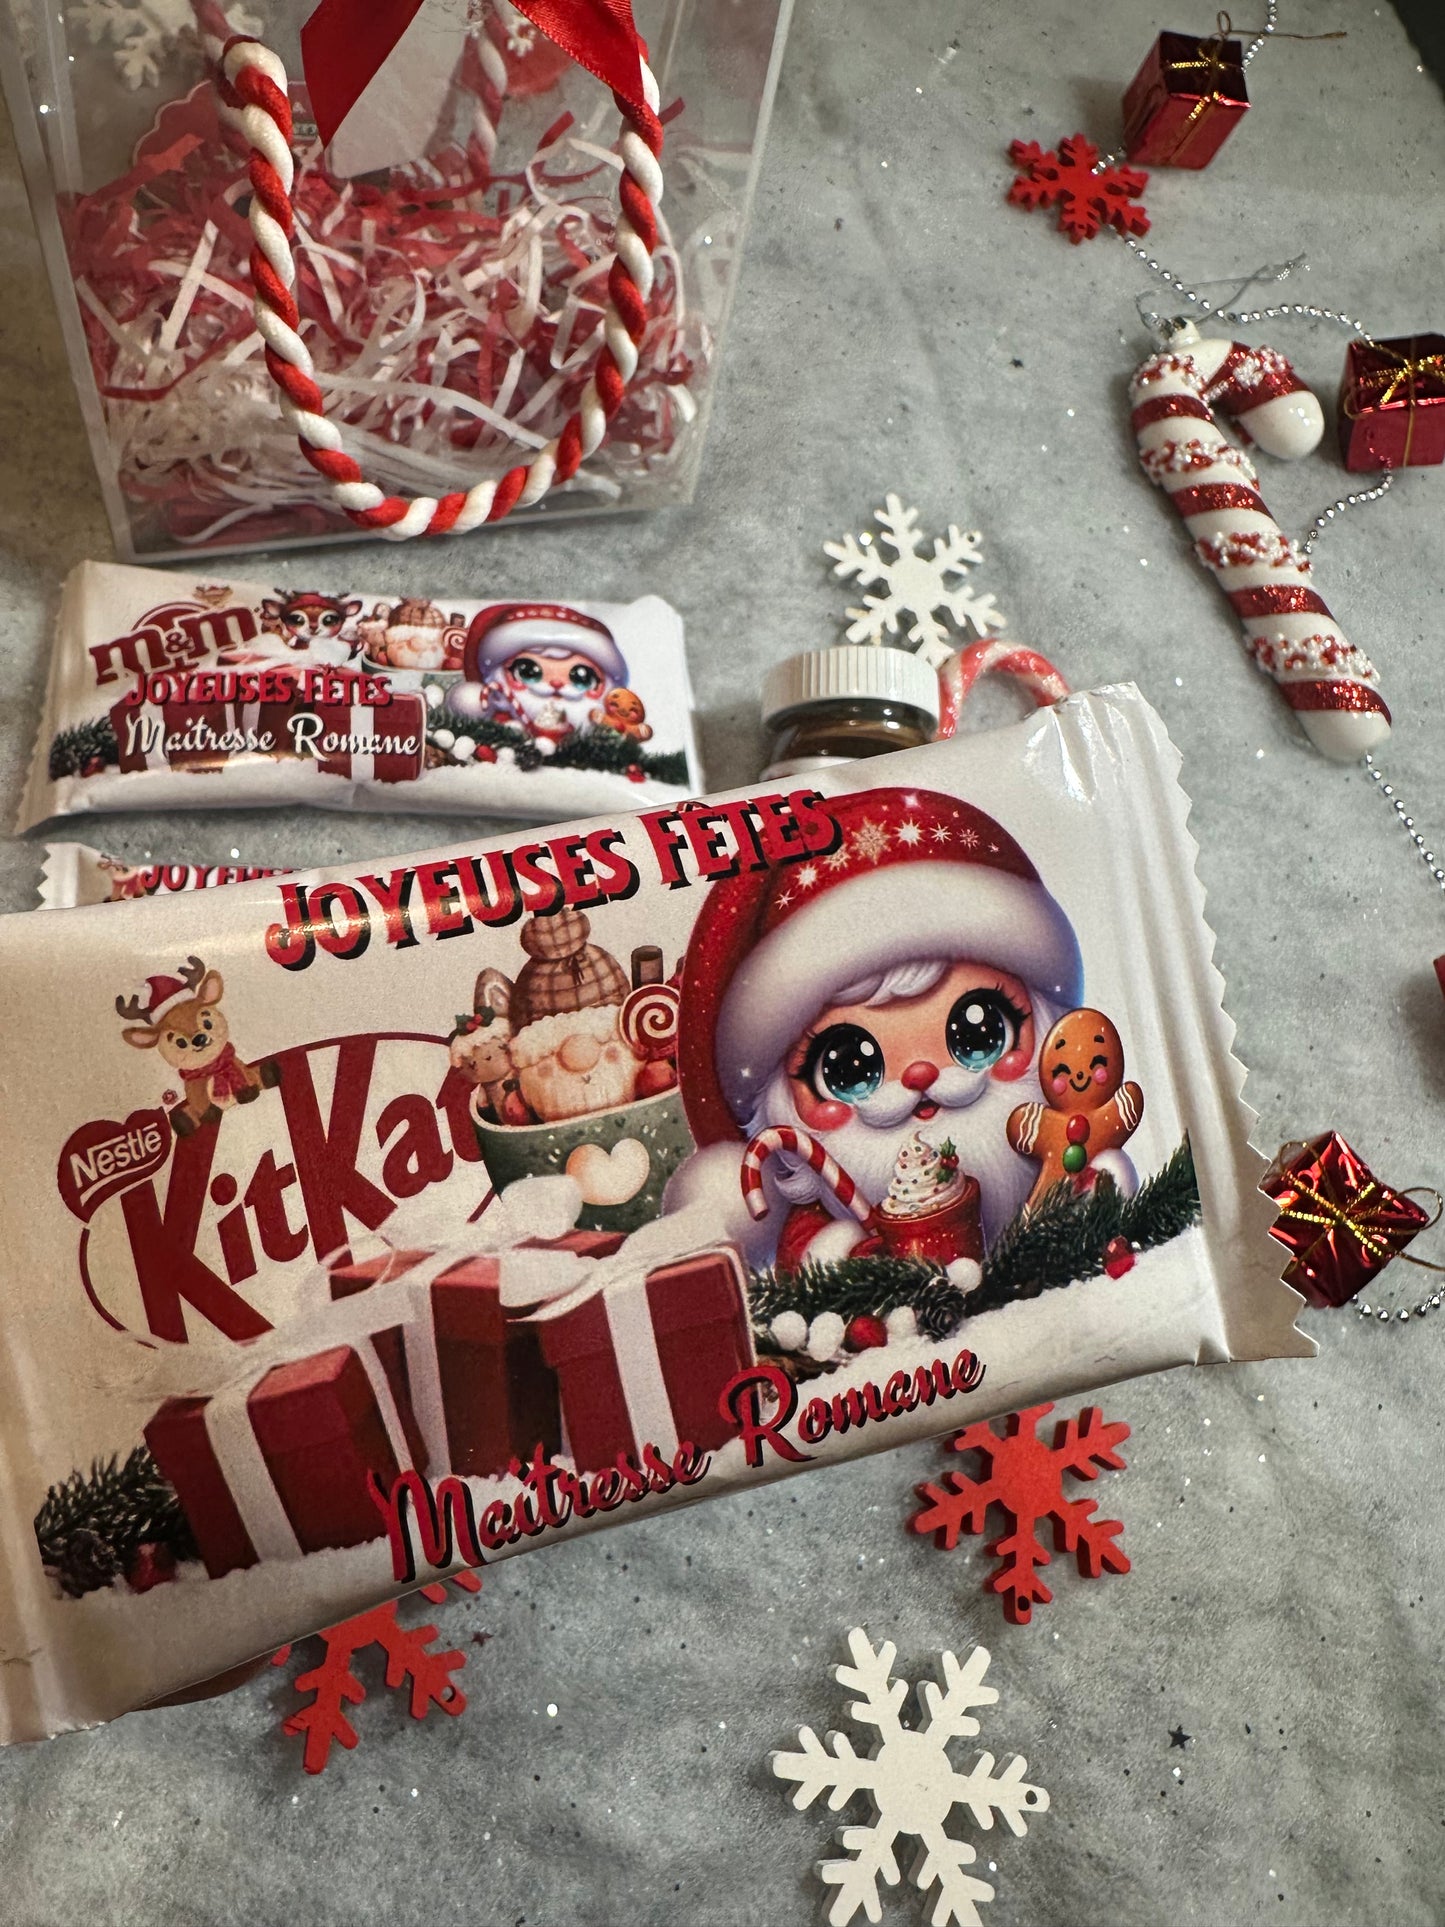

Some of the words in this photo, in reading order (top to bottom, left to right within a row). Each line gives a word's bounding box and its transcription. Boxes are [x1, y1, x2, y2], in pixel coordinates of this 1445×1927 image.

[124, 671, 296, 705] JOYEUSES
[287, 713, 421, 762] Romane
[265, 829, 640, 971] JOYEUSES
[637, 788, 843, 891] FÊTES
[719, 1349, 987, 1469] Romane
